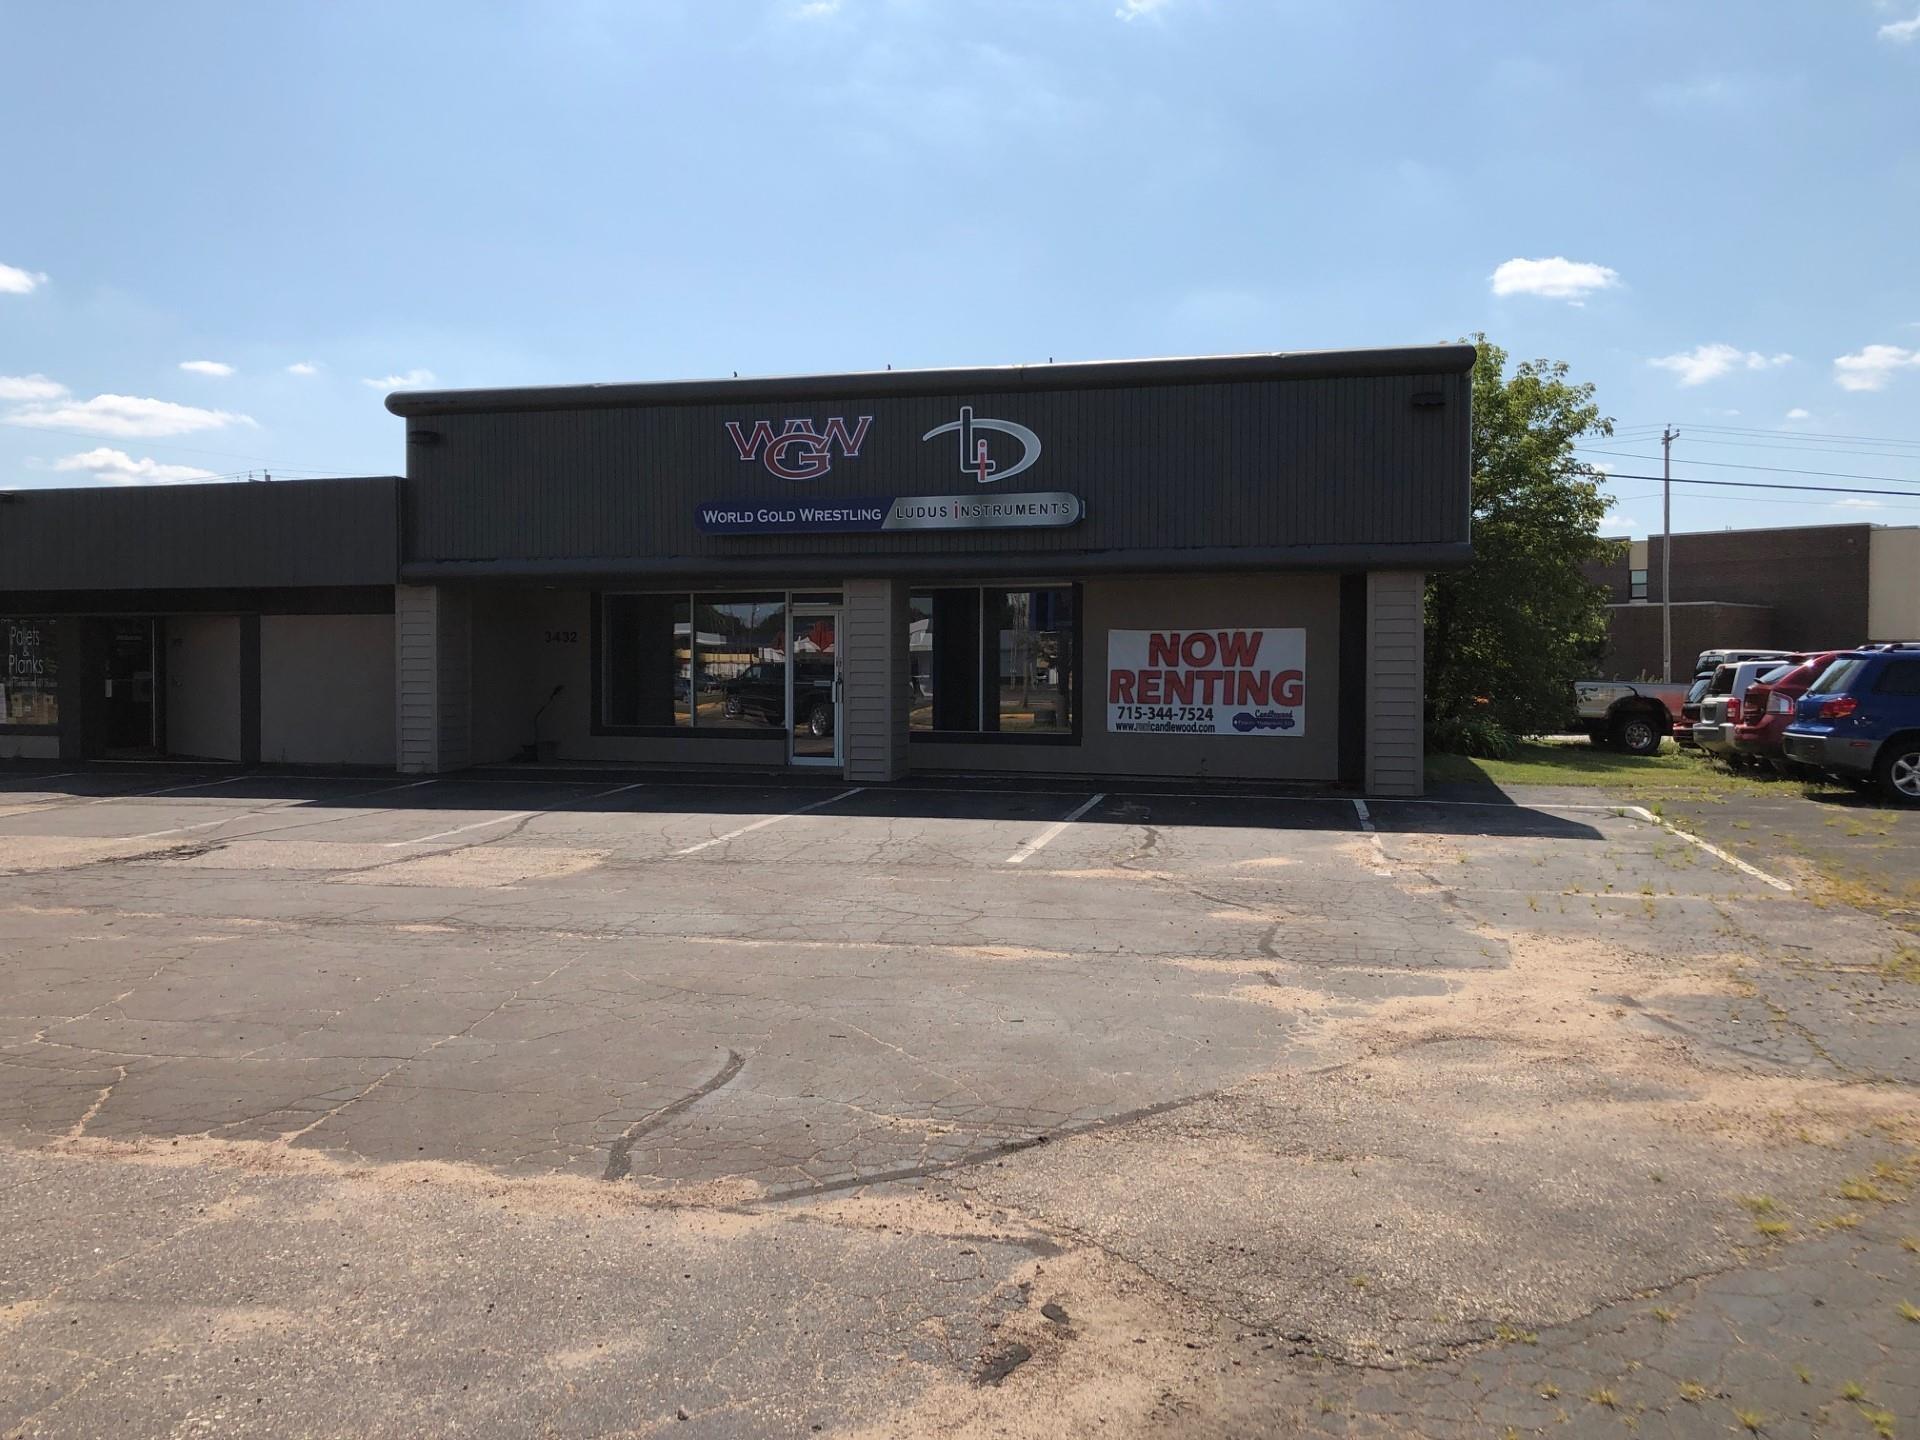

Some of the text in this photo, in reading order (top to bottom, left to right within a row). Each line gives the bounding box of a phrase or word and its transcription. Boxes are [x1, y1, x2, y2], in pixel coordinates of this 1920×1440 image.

[703, 507, 883, 524] WORLD GOLD WRESTLING
[896, 506, 948, 519] LUDUS
[544, 631, 577, 643] 3432
[1149, 632, 1263, 668] NOW
[1109, 670, 1303, 707] RENTING
[1117, 706, 1214, 721] 715-344-7524
